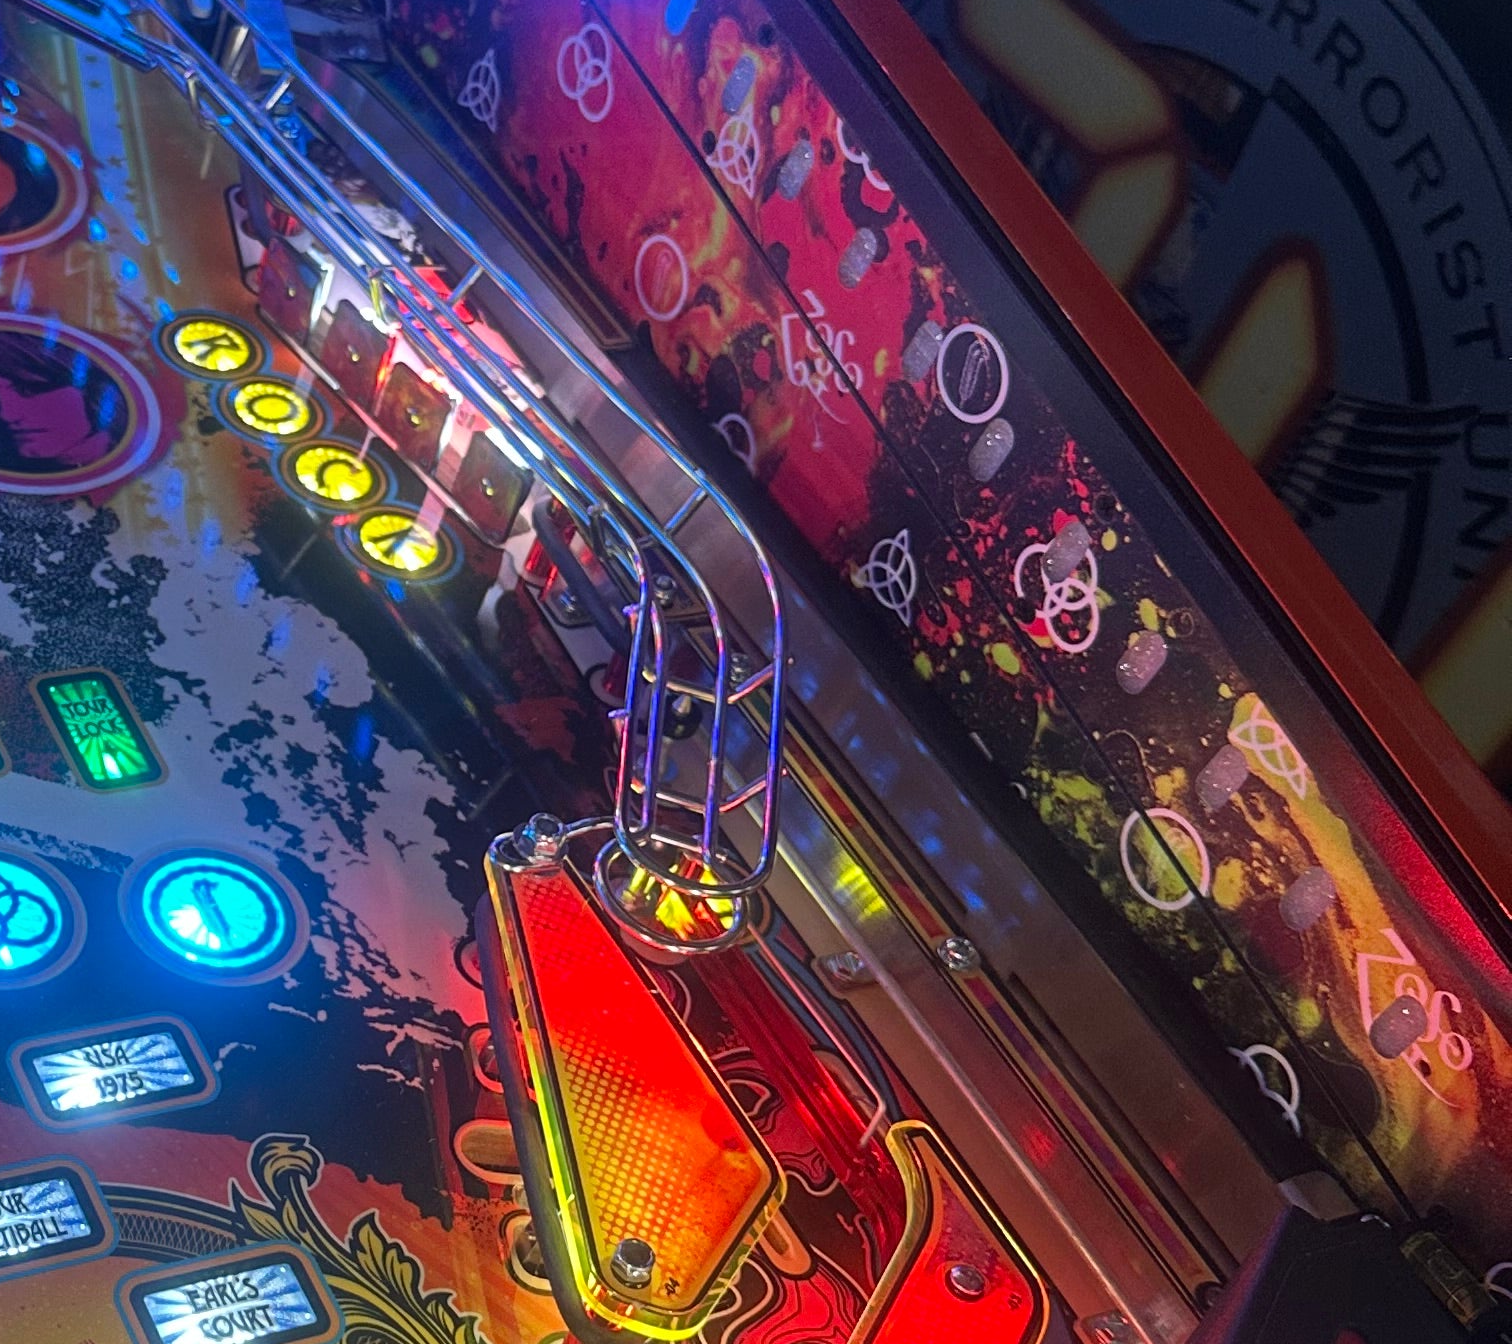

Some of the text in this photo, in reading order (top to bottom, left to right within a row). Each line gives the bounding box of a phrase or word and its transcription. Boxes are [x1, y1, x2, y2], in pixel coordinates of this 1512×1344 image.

[61, 698, 112, 718] TOUR
[74, 718, 122, 739] LOCK
[85, 1044, 132, 1068] USA
[95, 1070, 146, 1098] 1975
[187, 1275, 262, 1312] EARL'S
[197, 1306, 277, 1342] COURT
